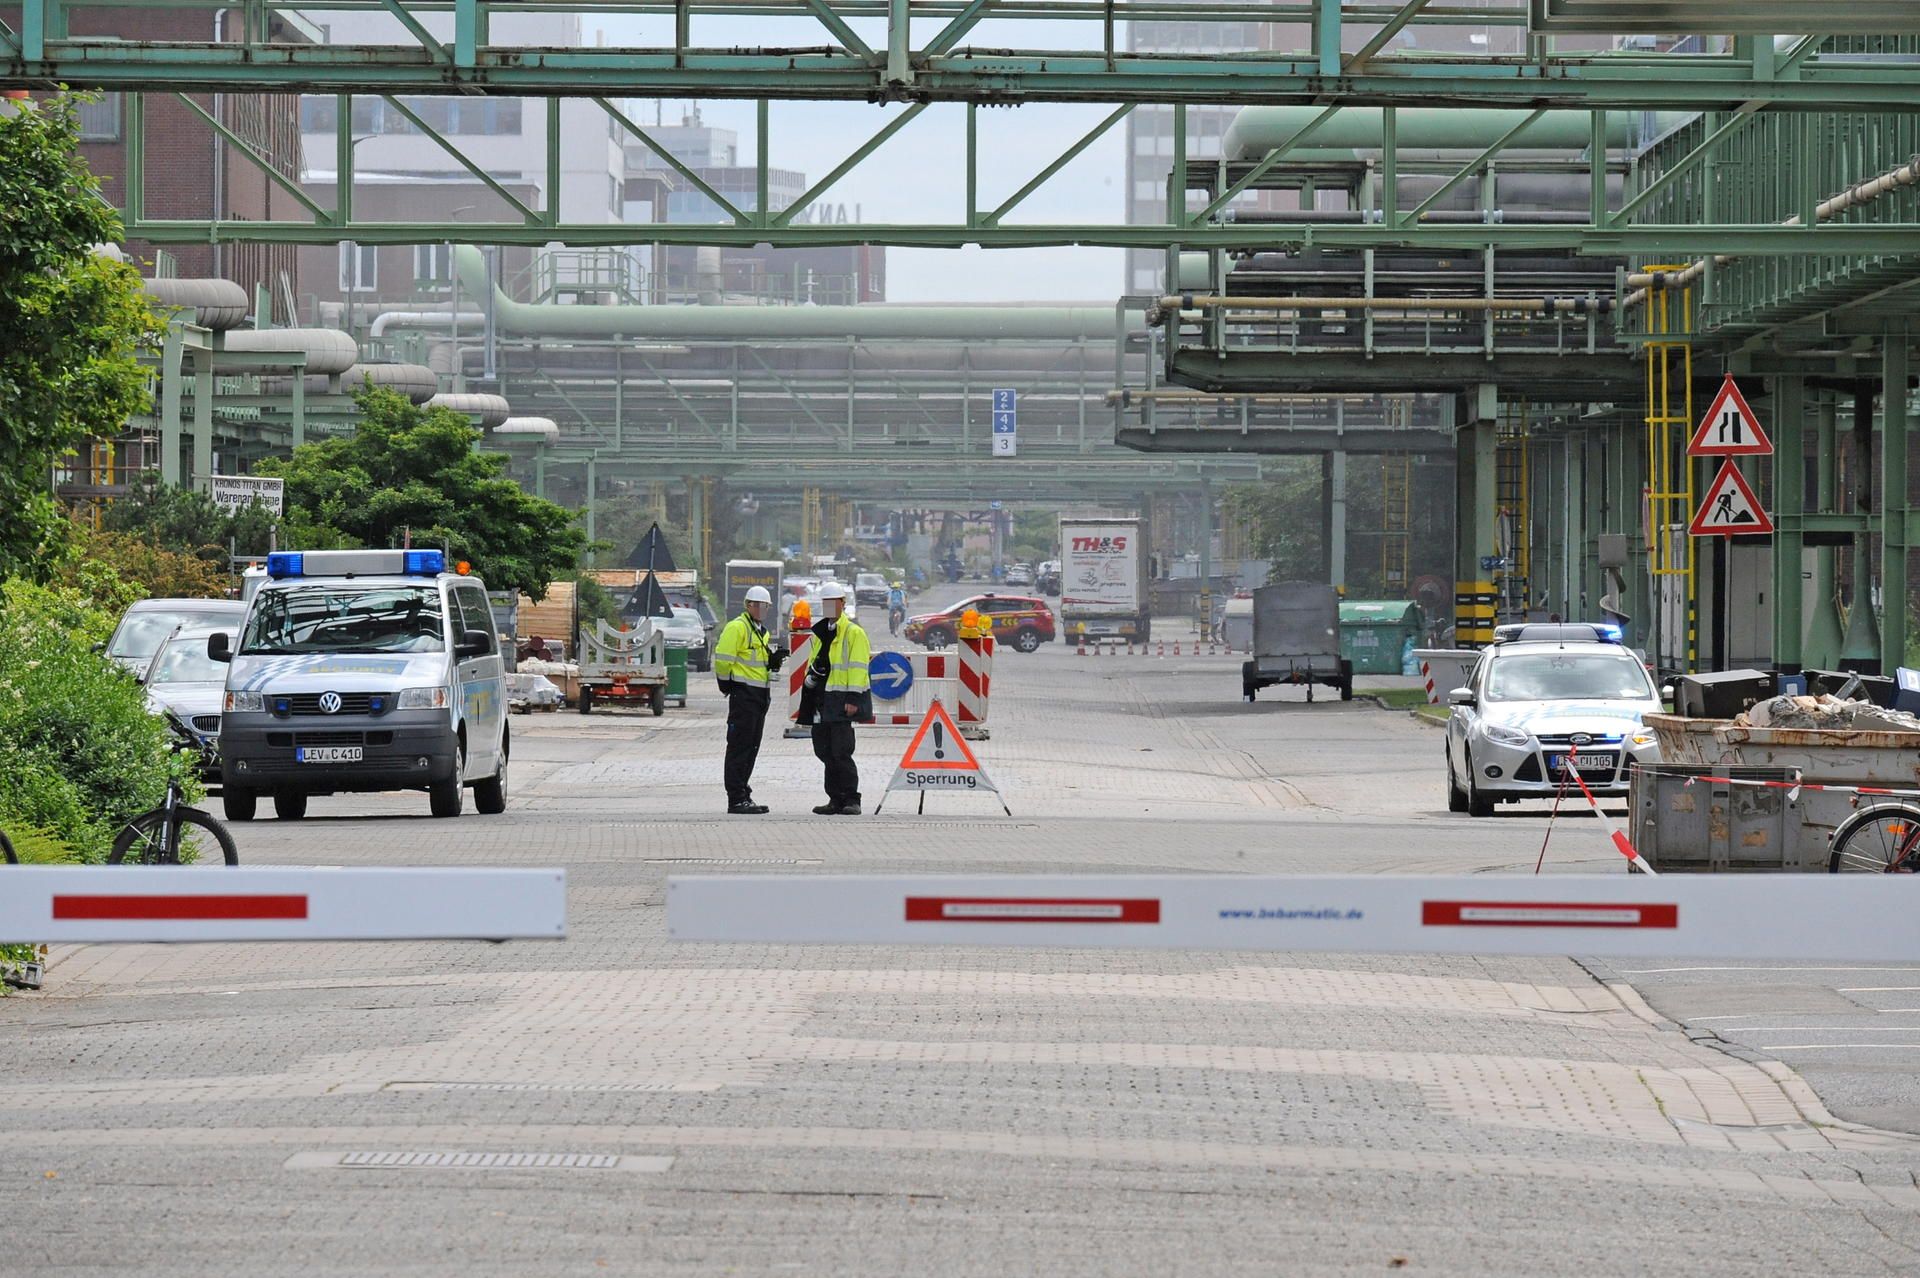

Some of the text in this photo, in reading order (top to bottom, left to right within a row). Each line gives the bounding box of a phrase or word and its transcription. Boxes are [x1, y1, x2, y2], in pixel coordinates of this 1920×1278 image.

[1000, 391, 1009, 402] 2
[1000, 413, 1009, 425] 4
[1000, 439, 1009, 450] 3
[215, 480, 240, 489] KRONOS
[243, 481, 261, 491] TITAN
[1071, 537, 1127, 551] TH&S
[303, 748, 361, 760] LEV C 410
[1594, 755, 1611, 767] 105
[906, 771, 977, 788] Sperrung
